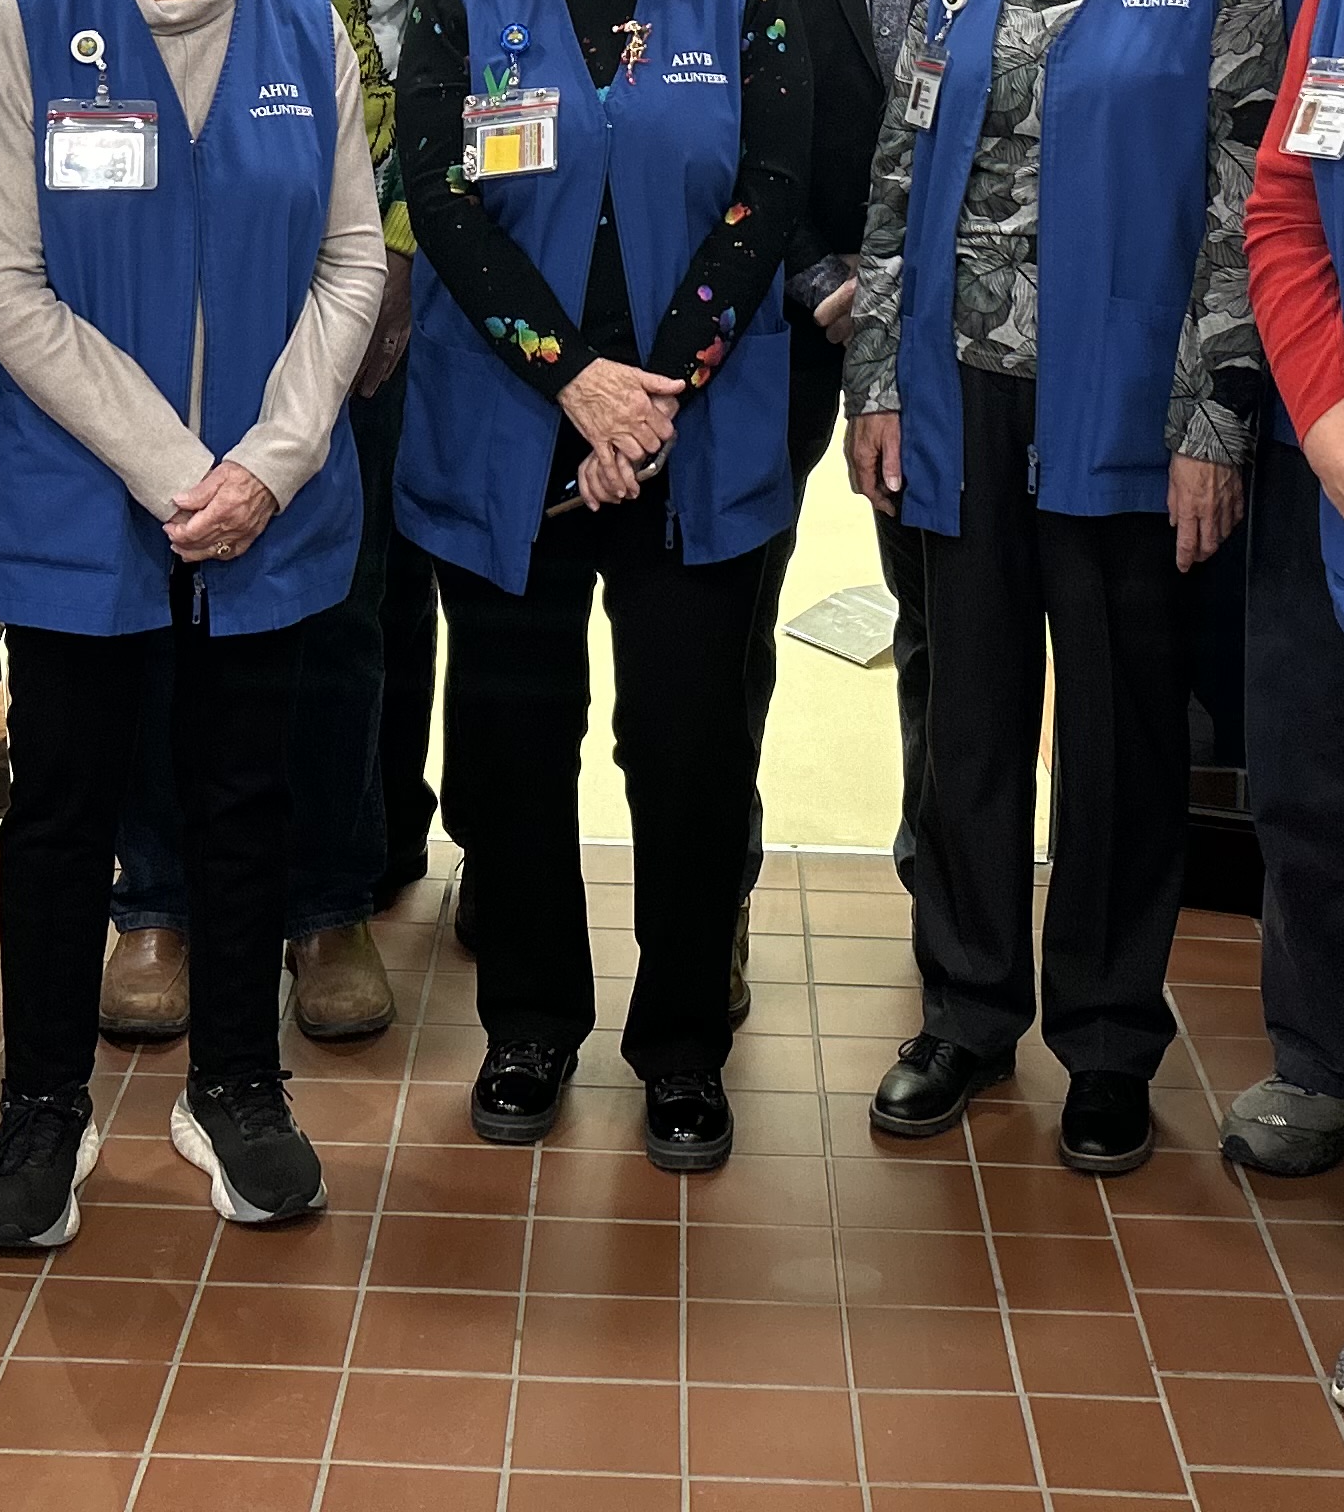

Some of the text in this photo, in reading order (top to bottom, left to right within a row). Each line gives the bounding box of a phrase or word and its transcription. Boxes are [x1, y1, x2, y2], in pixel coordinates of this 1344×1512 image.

[671, 51, 714, 67] AHVB
[662, 72, 729, 85] VOLUNTEER
[258, 83, 299, 99] AHVB
[249, 104, 314, 119] VOLUNTEER
